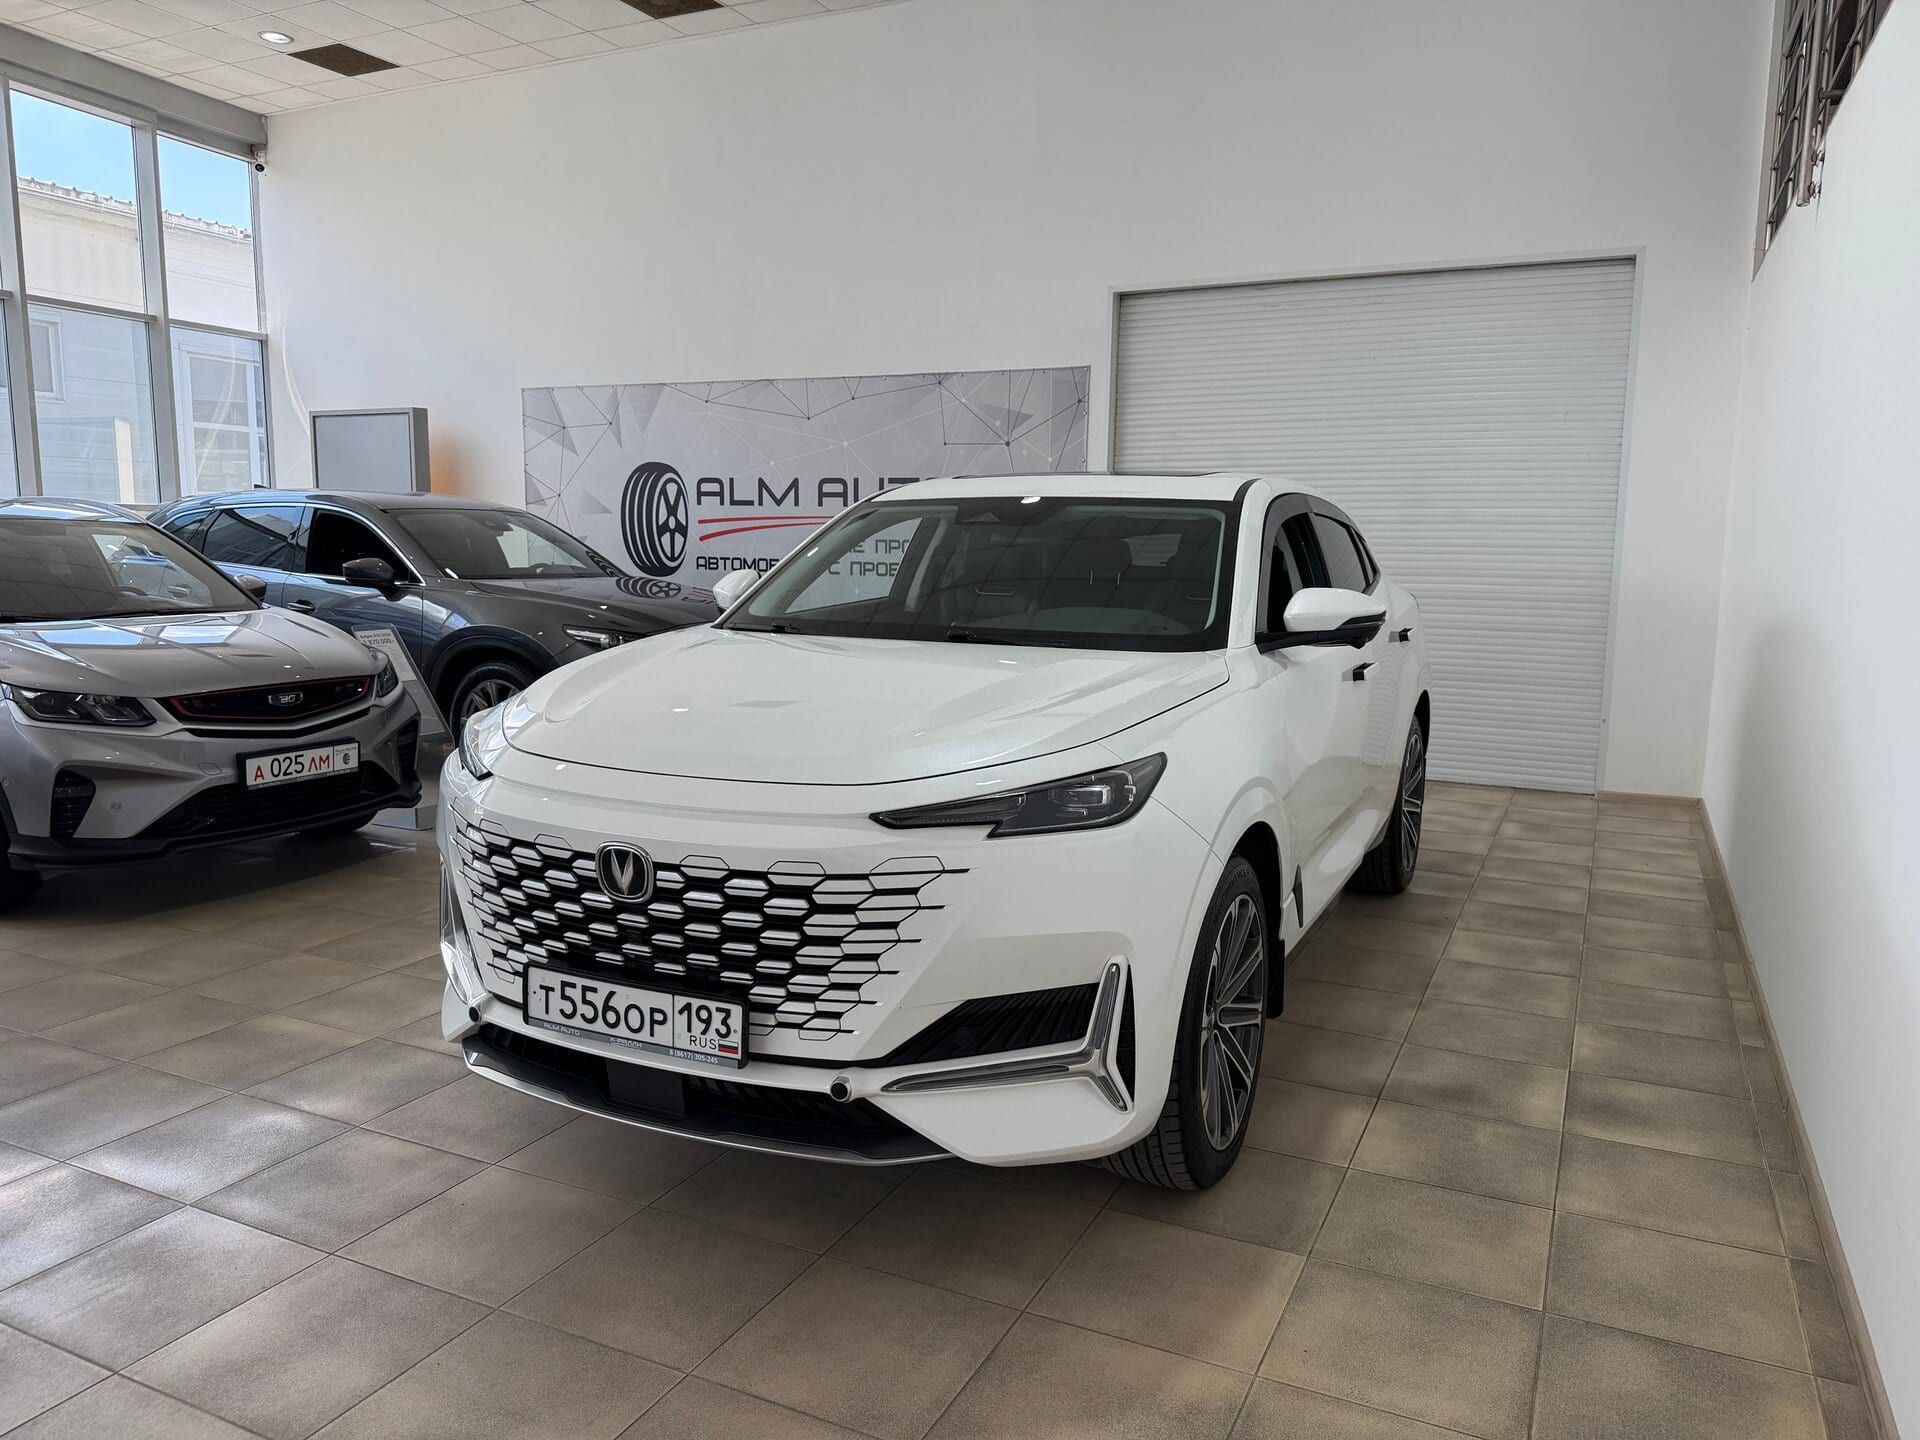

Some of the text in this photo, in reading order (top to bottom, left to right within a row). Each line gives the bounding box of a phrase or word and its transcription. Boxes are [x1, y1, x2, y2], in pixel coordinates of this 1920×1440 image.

[696, 477, 920, 507] ALM AUT
[270, 754, 305, 778] 025
[678, 1002, 732, 1039] 193
[689, 1035, 717, 1050] RUS
